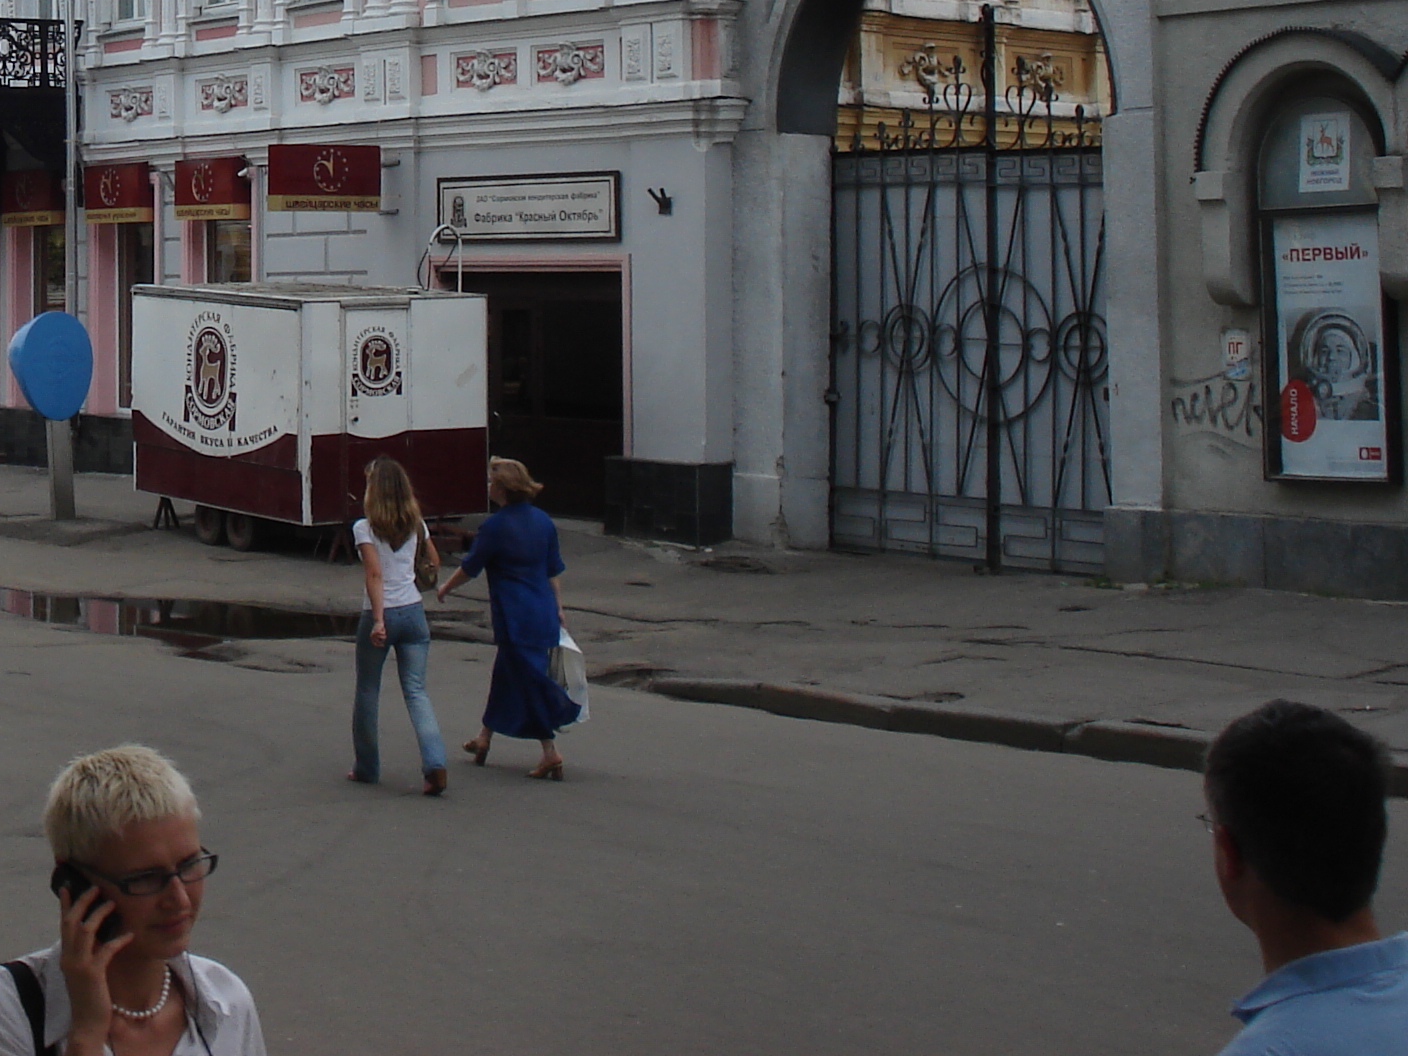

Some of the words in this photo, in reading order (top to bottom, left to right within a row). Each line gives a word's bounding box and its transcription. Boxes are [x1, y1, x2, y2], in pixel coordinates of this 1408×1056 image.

[285, 198, 351, 210] швейцарские
[353, 199, 379, 208] часы
[474, 212, 513, 225] Фабрика
[1282, 243, 1369, 263] «ПЕРВЫЙ»
[1227, 341, 1243, 355] ПГ
[186, 394, 236, 429] СОРМОВСКАЯ
[1290, 388, 1300, 435] НАЧАЛО
[162, 412, 196, 441] ГАРАНТИЯ
[200, 434, 225, 448] ВКУСА
[237, 425, 278, 447] КАЧЕСТВА
